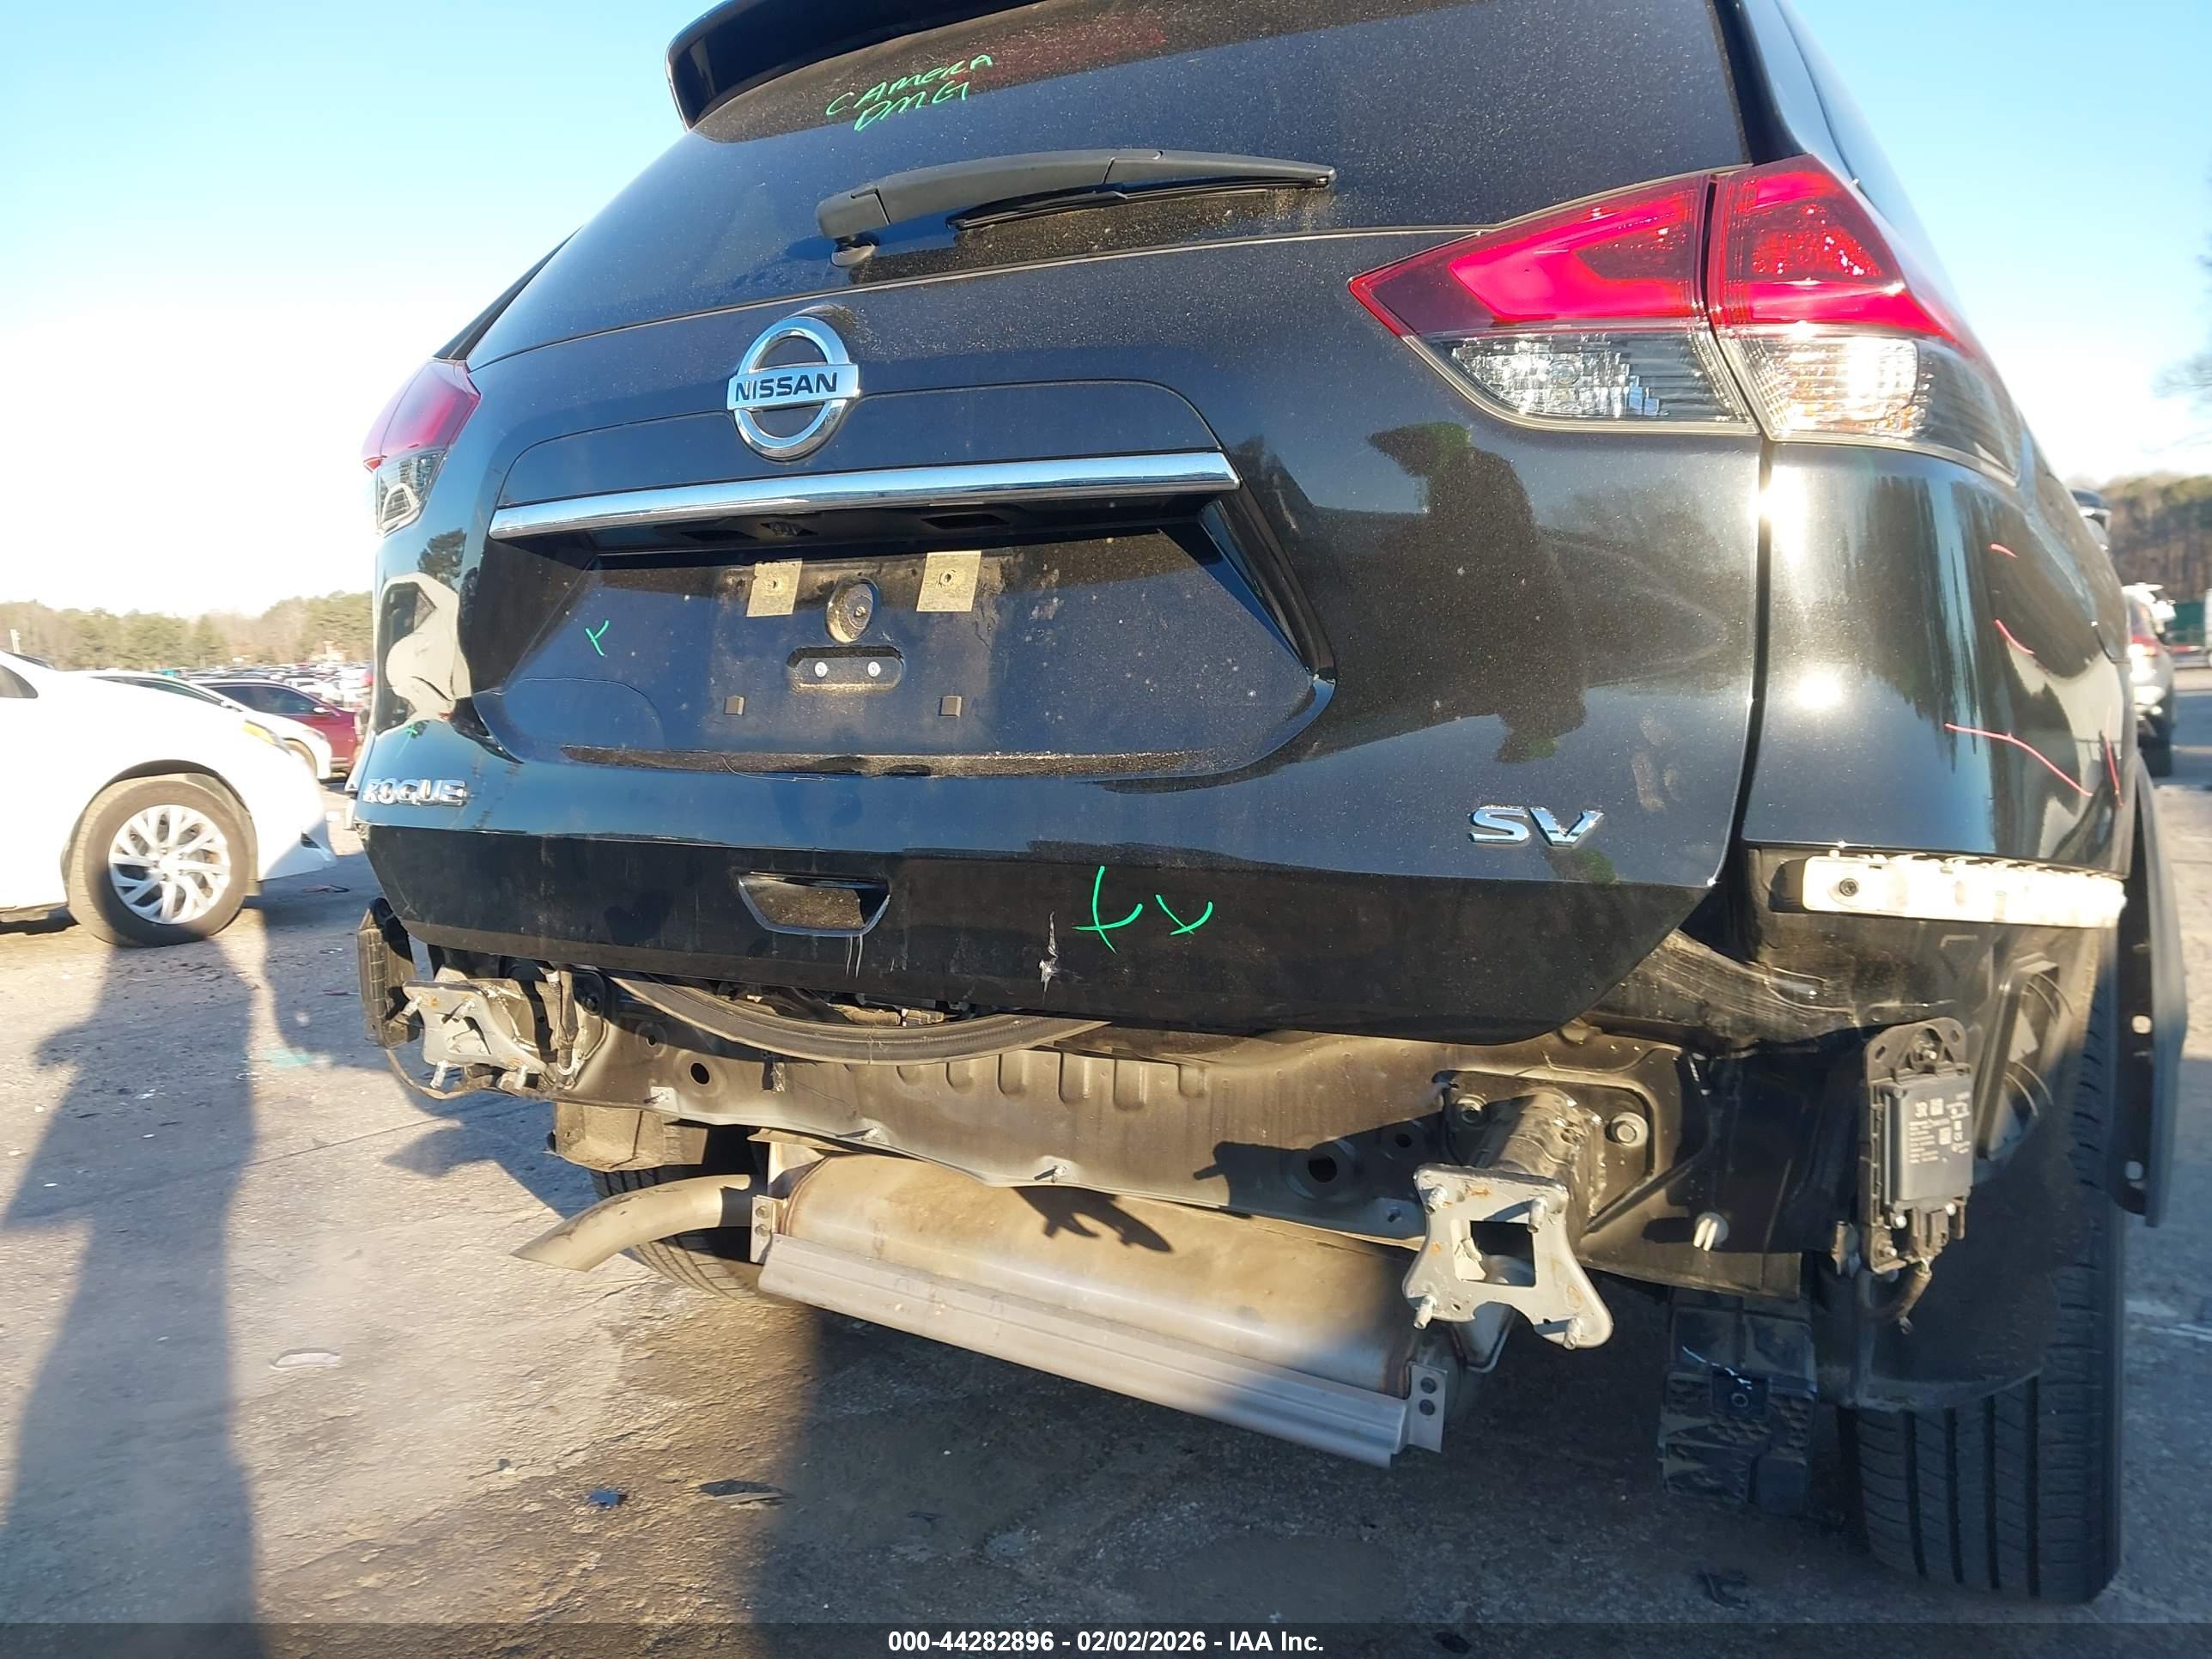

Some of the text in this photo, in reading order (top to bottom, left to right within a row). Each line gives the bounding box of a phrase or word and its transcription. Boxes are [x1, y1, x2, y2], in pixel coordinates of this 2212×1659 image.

[825, 54, 993, 115] CAMERA
[735, 372, 838, 402] NISSAN
[362, 778, 468, 806] ROGUE
[1469, 805, 1604, 848] SV
